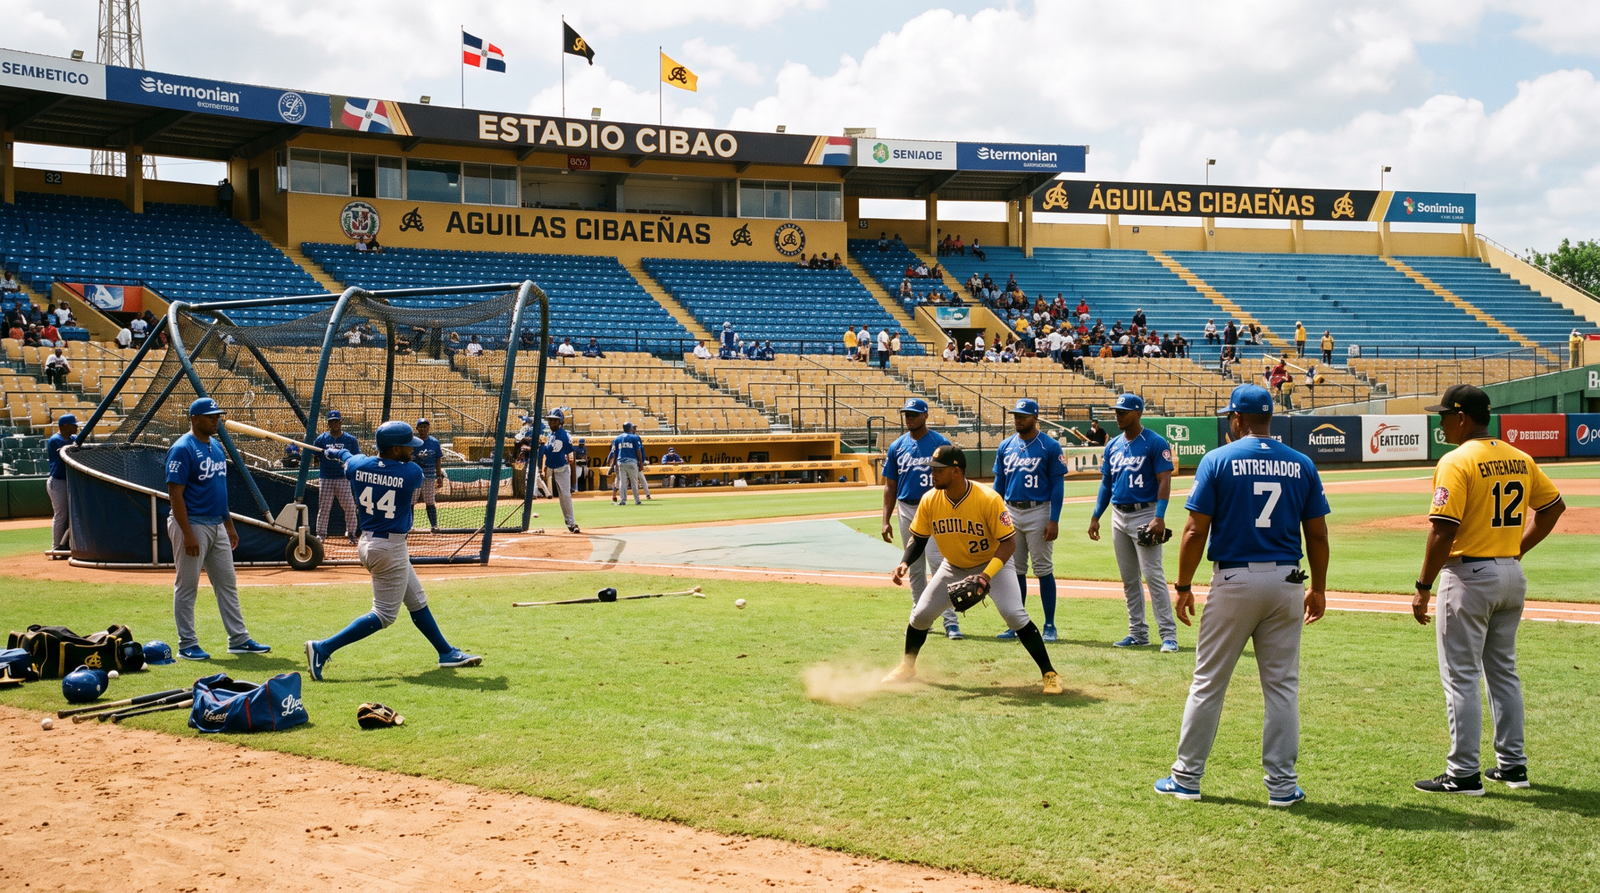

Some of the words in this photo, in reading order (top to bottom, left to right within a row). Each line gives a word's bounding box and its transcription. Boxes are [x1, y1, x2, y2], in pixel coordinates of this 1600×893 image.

[2, 61, 89, 85] SEMBETICO
[157, 79, 241, 104] termonian
[479, 114, 625, 151] ESTADIO
[636, 128, 738, 158] CIBAO
[893, 149, 942, 161] SENIADE
[990, 148, 1058, 162] termonian
[46, 172, 61, 184] 32
[1089, 183, 1192, 212] ÁGUILAS
[1199, 189, 1315, 216] CIBAEÑAS
[1417, 202, 1465, 214] Sonimina
[446, 211, 566, 238] AGUILAS
[575, 216, 711, 245] CIBAEÑAS
[1003, 452, 1042, 475] Licey
[1109, 451, 1146, 475] Licey
[1231, 458, 1301, 479] ENTRENADOR
[1478, 459, 1528, 478] ENTRENADOR
[355, 470, 404, 488] ENTRENADOR
[919, 473, 934, 487] 31
[1024, 474, 1039, 488] 31
[1128, 473, 1144, 488] 14
[358, 486, 397, 519] 44
[1253, 481, 1282, 528] 7
[1491, 480, 1524, 528] 12
[932, 518, 985, 537] AGUILAS
[968, 538, 990, 554] 28
